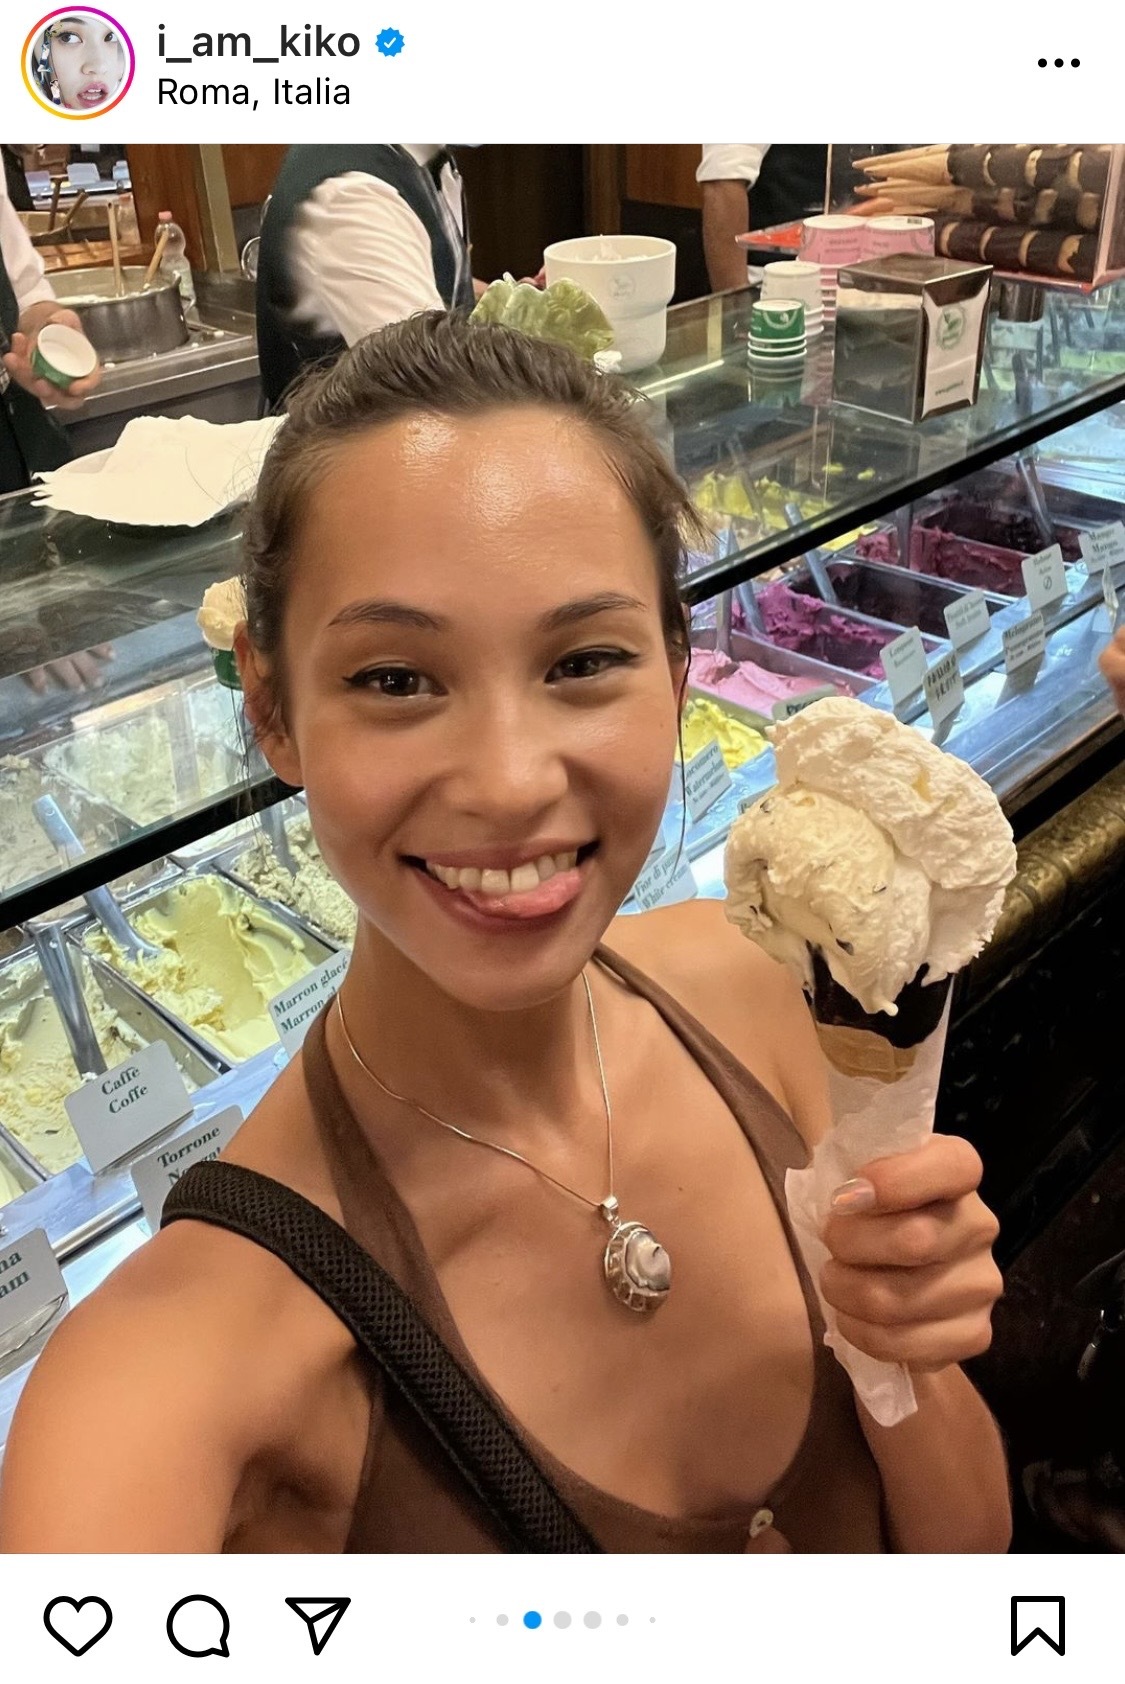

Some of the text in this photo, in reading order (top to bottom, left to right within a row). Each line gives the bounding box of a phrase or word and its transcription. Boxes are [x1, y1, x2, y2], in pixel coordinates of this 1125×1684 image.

[273, 982, 319, 1018] Marron
[280, 999, 325, 1035] Marron
[101, 1066, 140, 1095] Caffe
[109, 1085, 148, 1114] Coffe
[157, 1127, 220, 1168] Torrone
